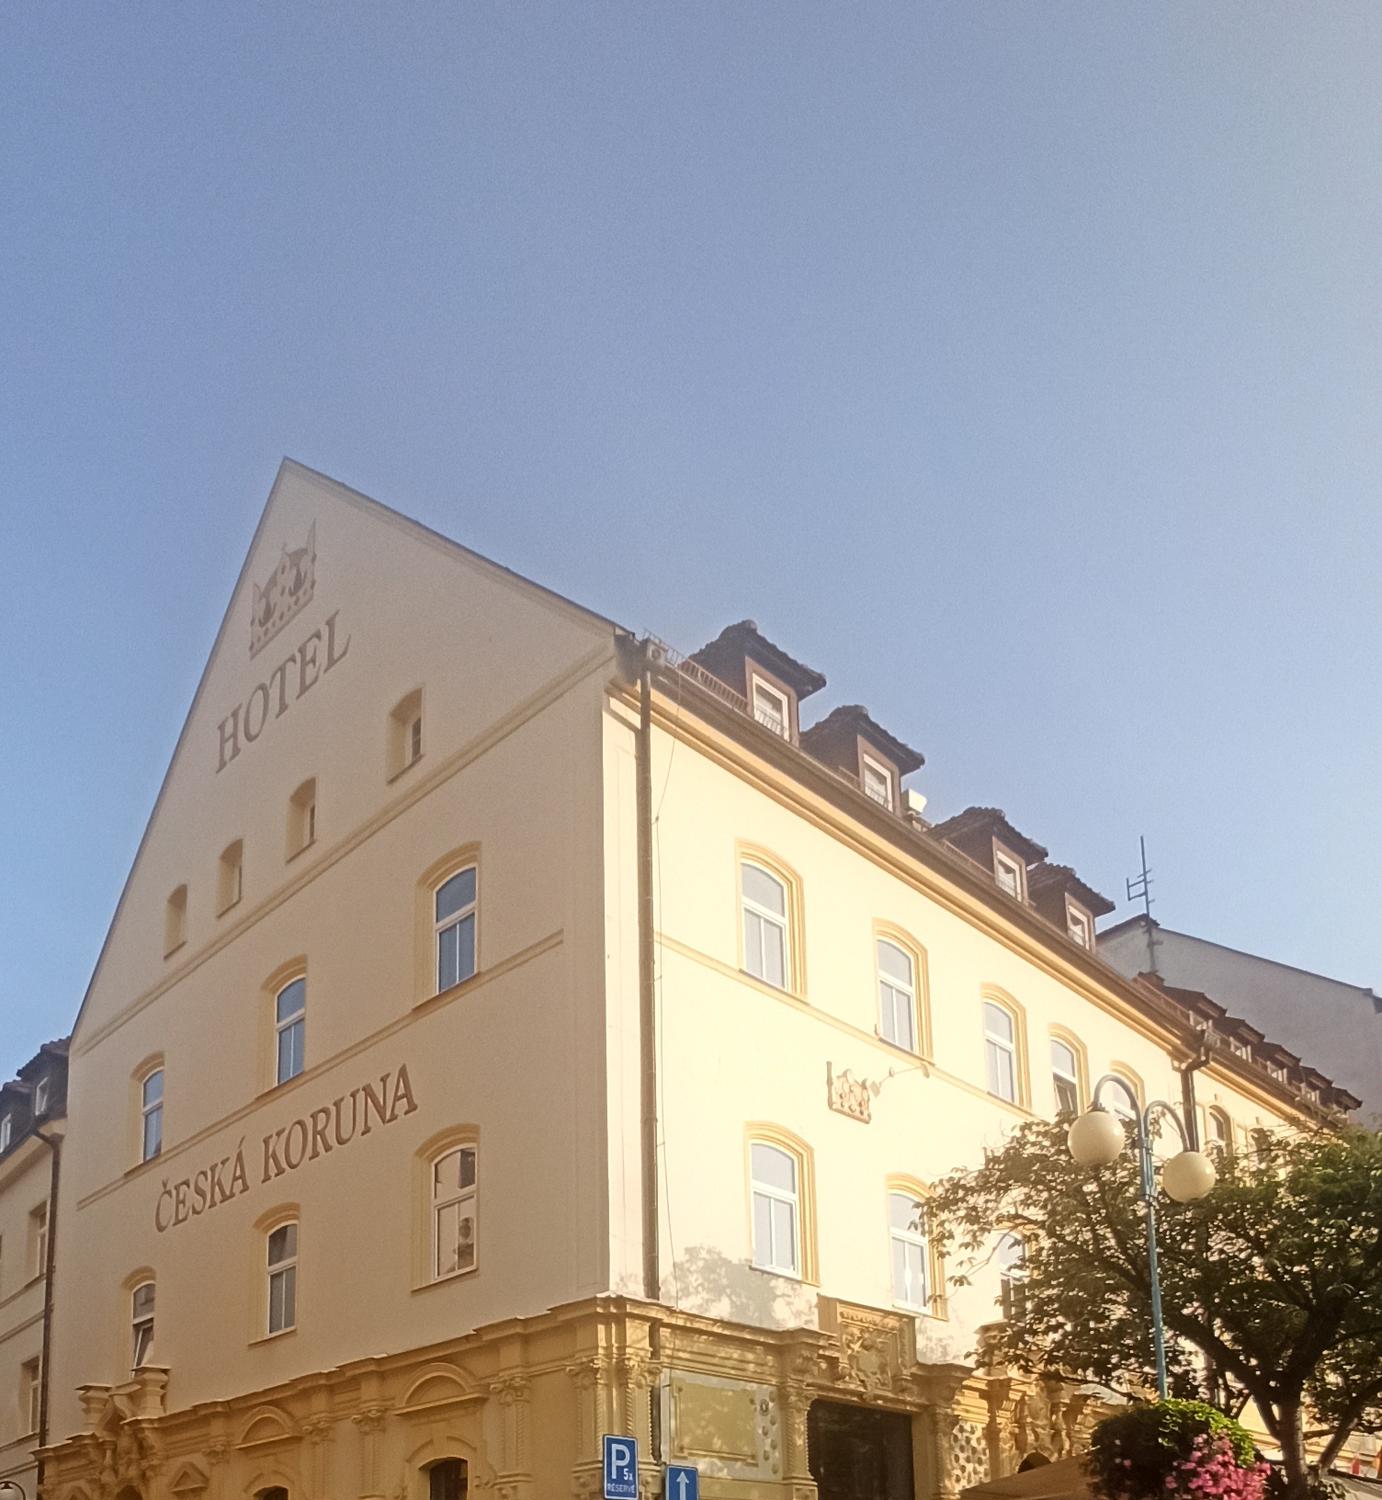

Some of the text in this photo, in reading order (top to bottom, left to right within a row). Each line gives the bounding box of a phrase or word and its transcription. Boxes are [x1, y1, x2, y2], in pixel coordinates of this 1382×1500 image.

[215, 608, 352, 775] HOTEL
[154, 1062, 419, 1233] ČESKÁ KORUNA
[611, 1443, 630, 1479] P
[623, 1468, 633, 1481] 5x
